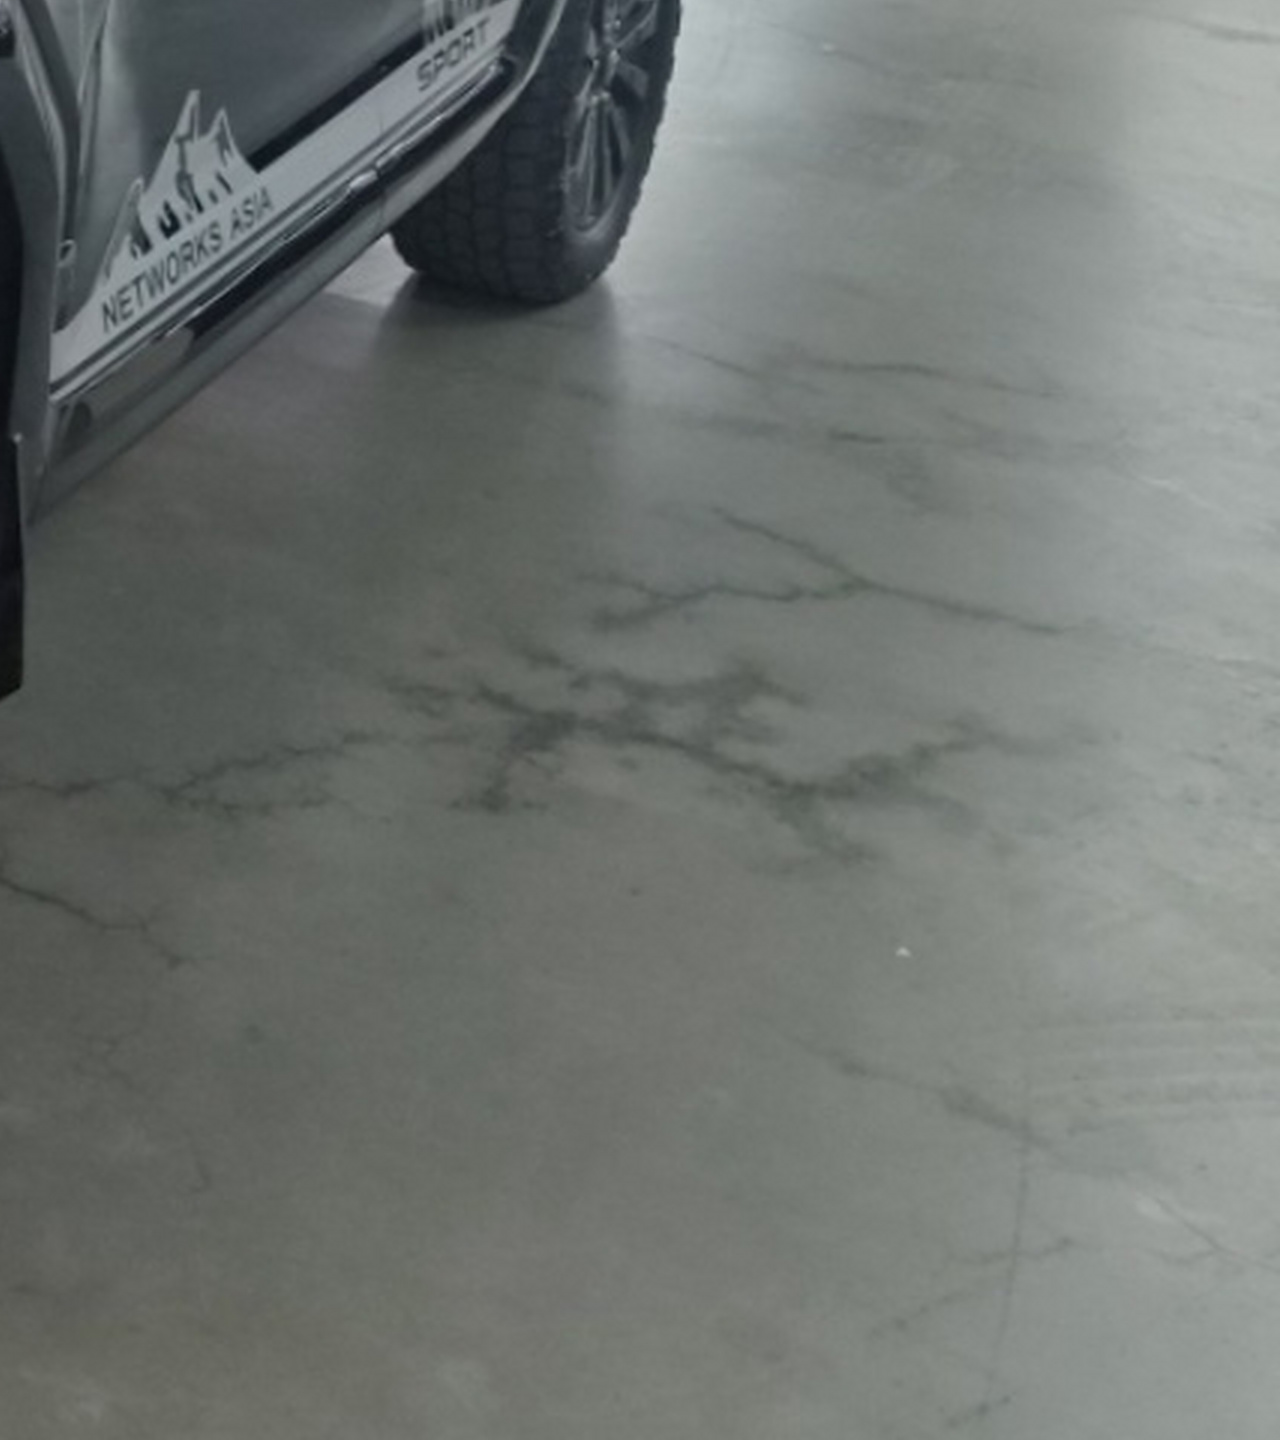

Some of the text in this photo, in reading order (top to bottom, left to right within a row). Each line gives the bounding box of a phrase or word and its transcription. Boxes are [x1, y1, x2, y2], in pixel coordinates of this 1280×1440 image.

[417, 16, 491, 92] SPORT
[101, 186, 275, 334] NETWORKS ASIA
